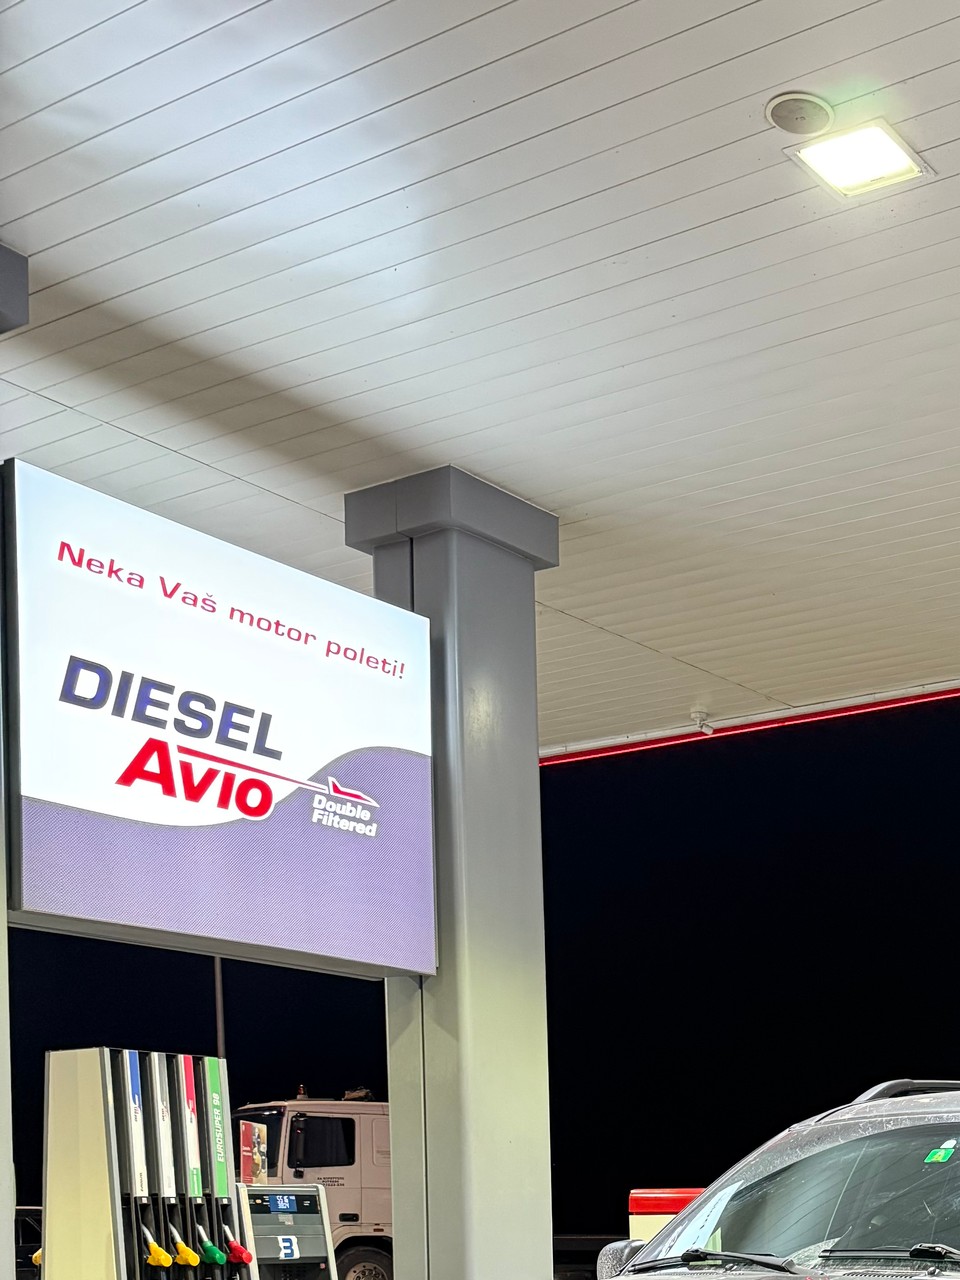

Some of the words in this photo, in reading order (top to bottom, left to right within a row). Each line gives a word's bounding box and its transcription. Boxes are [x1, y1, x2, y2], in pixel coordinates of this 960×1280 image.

[58, 541, 145, 589] Neka
[159, 576, 217, 613] Vaš
[229, 607, 317, 645] motor
[325, 640, 405, 679] poleti!
[59, 655, 282, 761] DIESEL
[312, 808, 377, 837] Filtered
[313, 794, 371, 821] Double
[213, 1108, 224, 1163] EUROSUPER
[281, 1237, 295, 1259] 3
